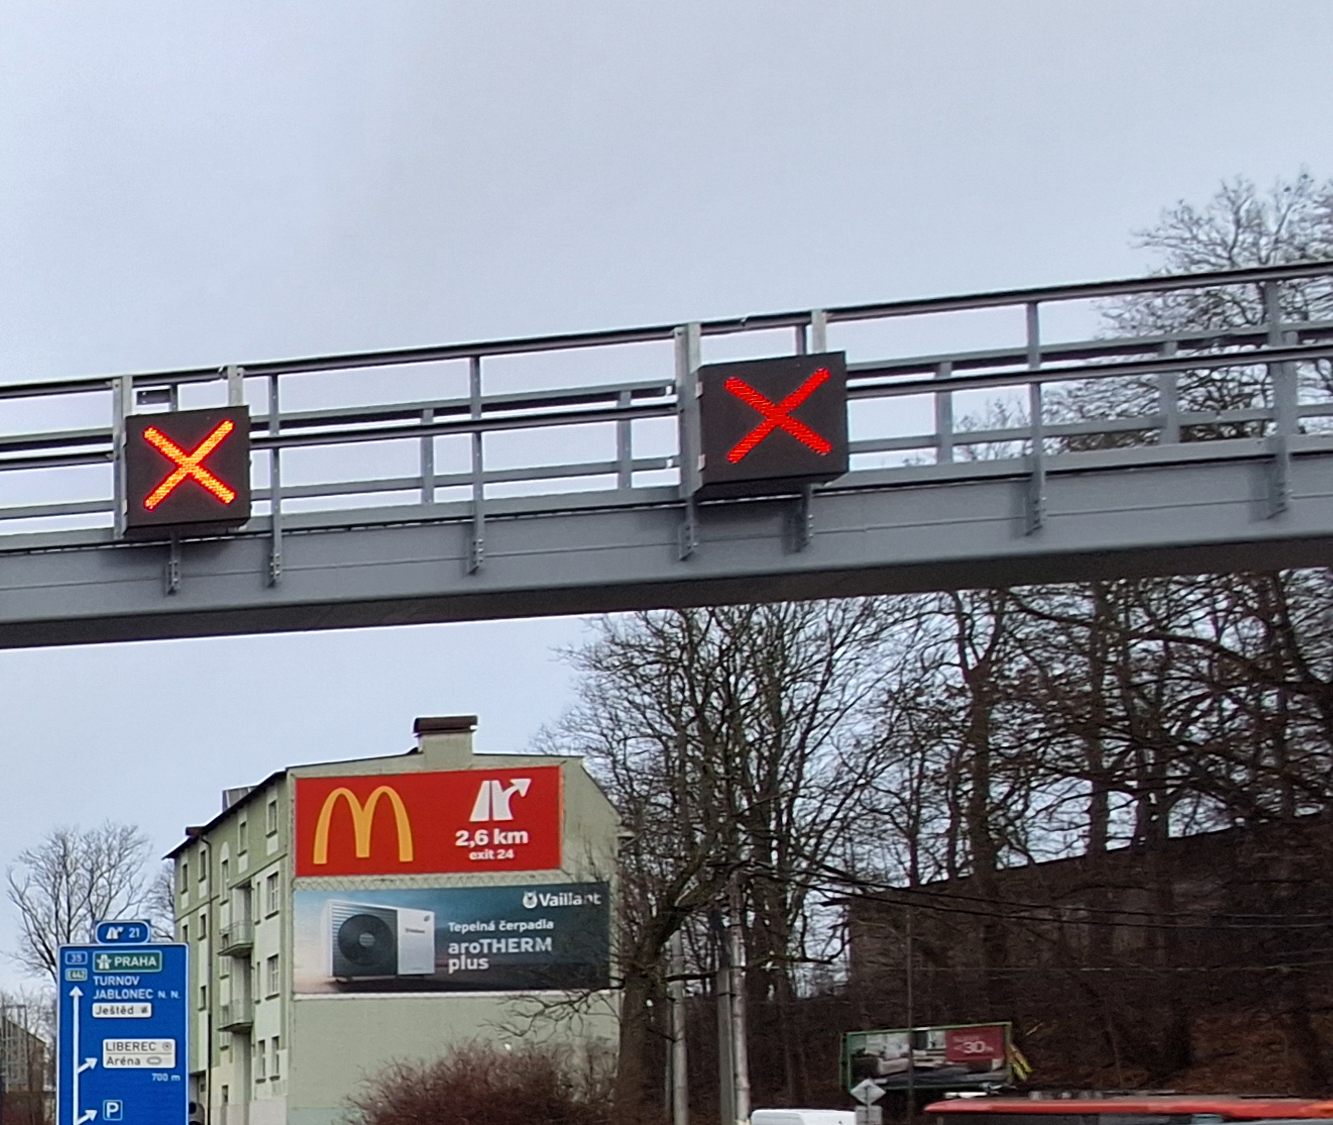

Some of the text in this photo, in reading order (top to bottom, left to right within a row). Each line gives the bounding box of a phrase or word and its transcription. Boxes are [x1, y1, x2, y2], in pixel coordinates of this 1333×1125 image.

[455, 828, 528, 848] 2,6 km
[469, 849, 515, 860] exit 24
[539, 891, 602, 907] Vaillant
[448, 918, 554, 933] Tepelná čerpadla
[129, 927, 140, 938] 21
[448, 937, 552, 954] aroTHERM
[71, 954, 82, 962] 35
[114, 956, 157, 967] PRAHA
[448, 955, 489, 974] plus
[93, 976, 140, 986] TURNOV
[93, 989, 153, 999] JABLONEC
[95, 1005, 134, 1015] Ještěd
[105, 1041, 157, 1051] LIBEREC
[106, 1056, 141, 1066] Aréna
[152, 1073, 168, 1081] 700
